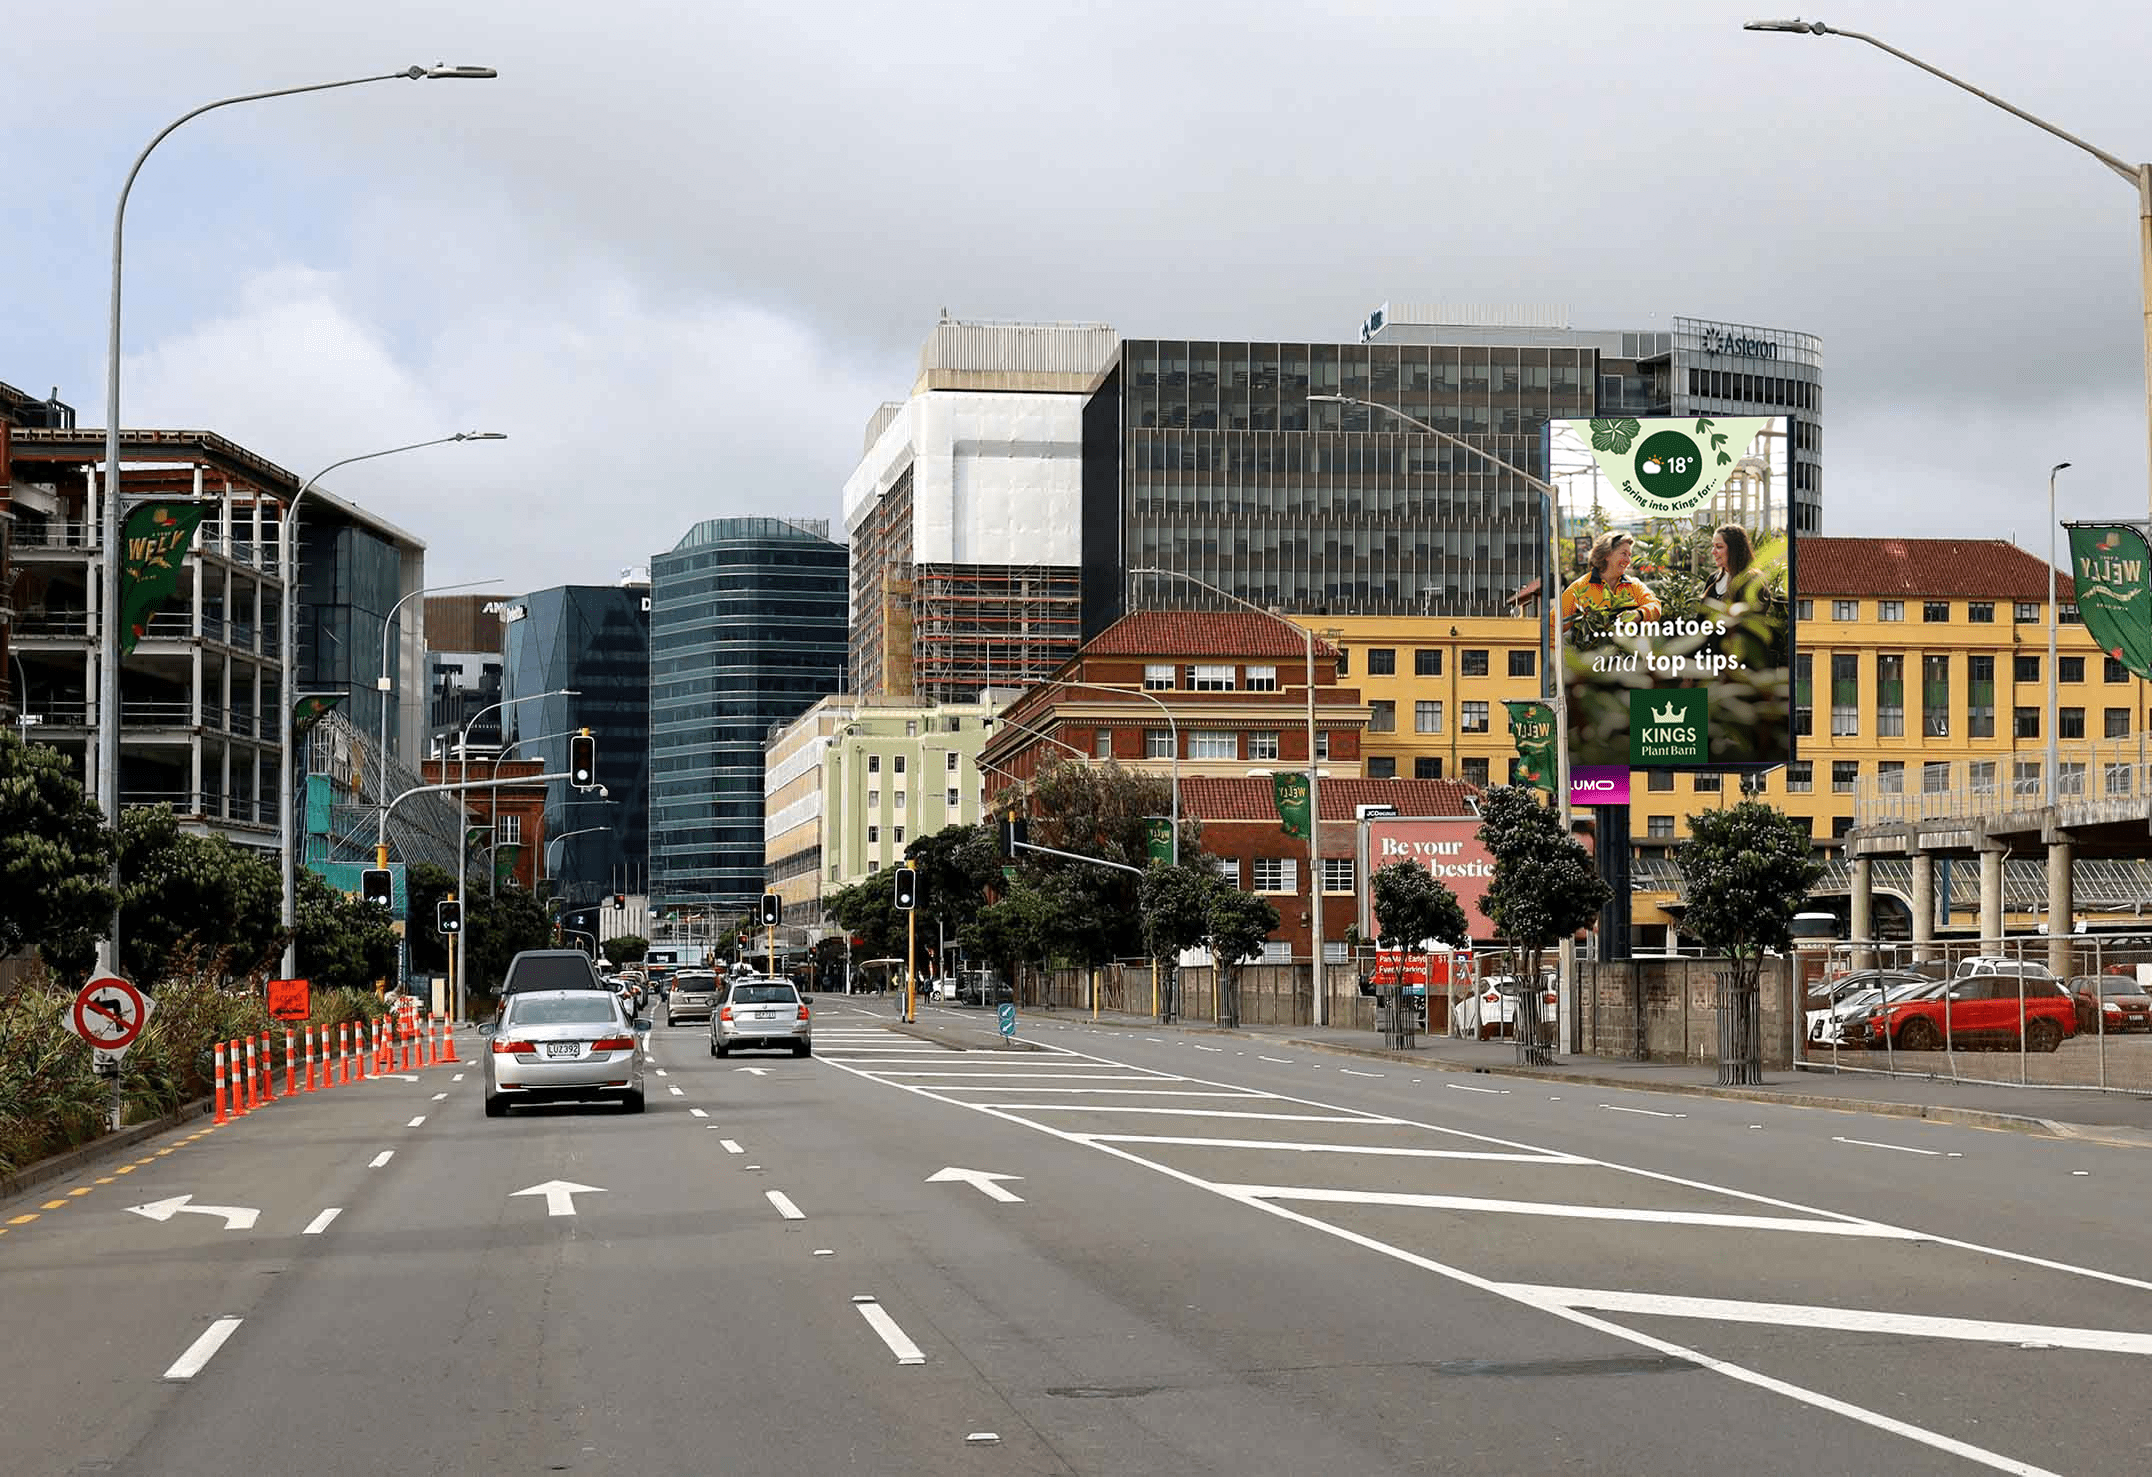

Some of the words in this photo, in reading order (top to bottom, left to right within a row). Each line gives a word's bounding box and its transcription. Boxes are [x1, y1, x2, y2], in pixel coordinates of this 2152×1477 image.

[1724, 332, 1778, 360] Asteron
[1667, 456, 1694, 474] 18°
[1622, 479, 1648, 508] Spring
[1648, 499, 1669, 511] into
[1671, 496, 1699, 512] Kings
[1697, 478, 1717, 499] for...
[1593, 616, 1727, 637] ...tomatoes
[1592, 651, 1638, 672] and
[1646, 650, 1686, 677] top
[1694, 647, 1746, 676] tips.
[1641, 727, 1697, 743] KINGS
[1641, 746, 1669, 756] Plant
[1670, 745, 1697, 756] Barn
[1381, 837, 1409, 856] Be
[1413, 841, 1464, 858] your
